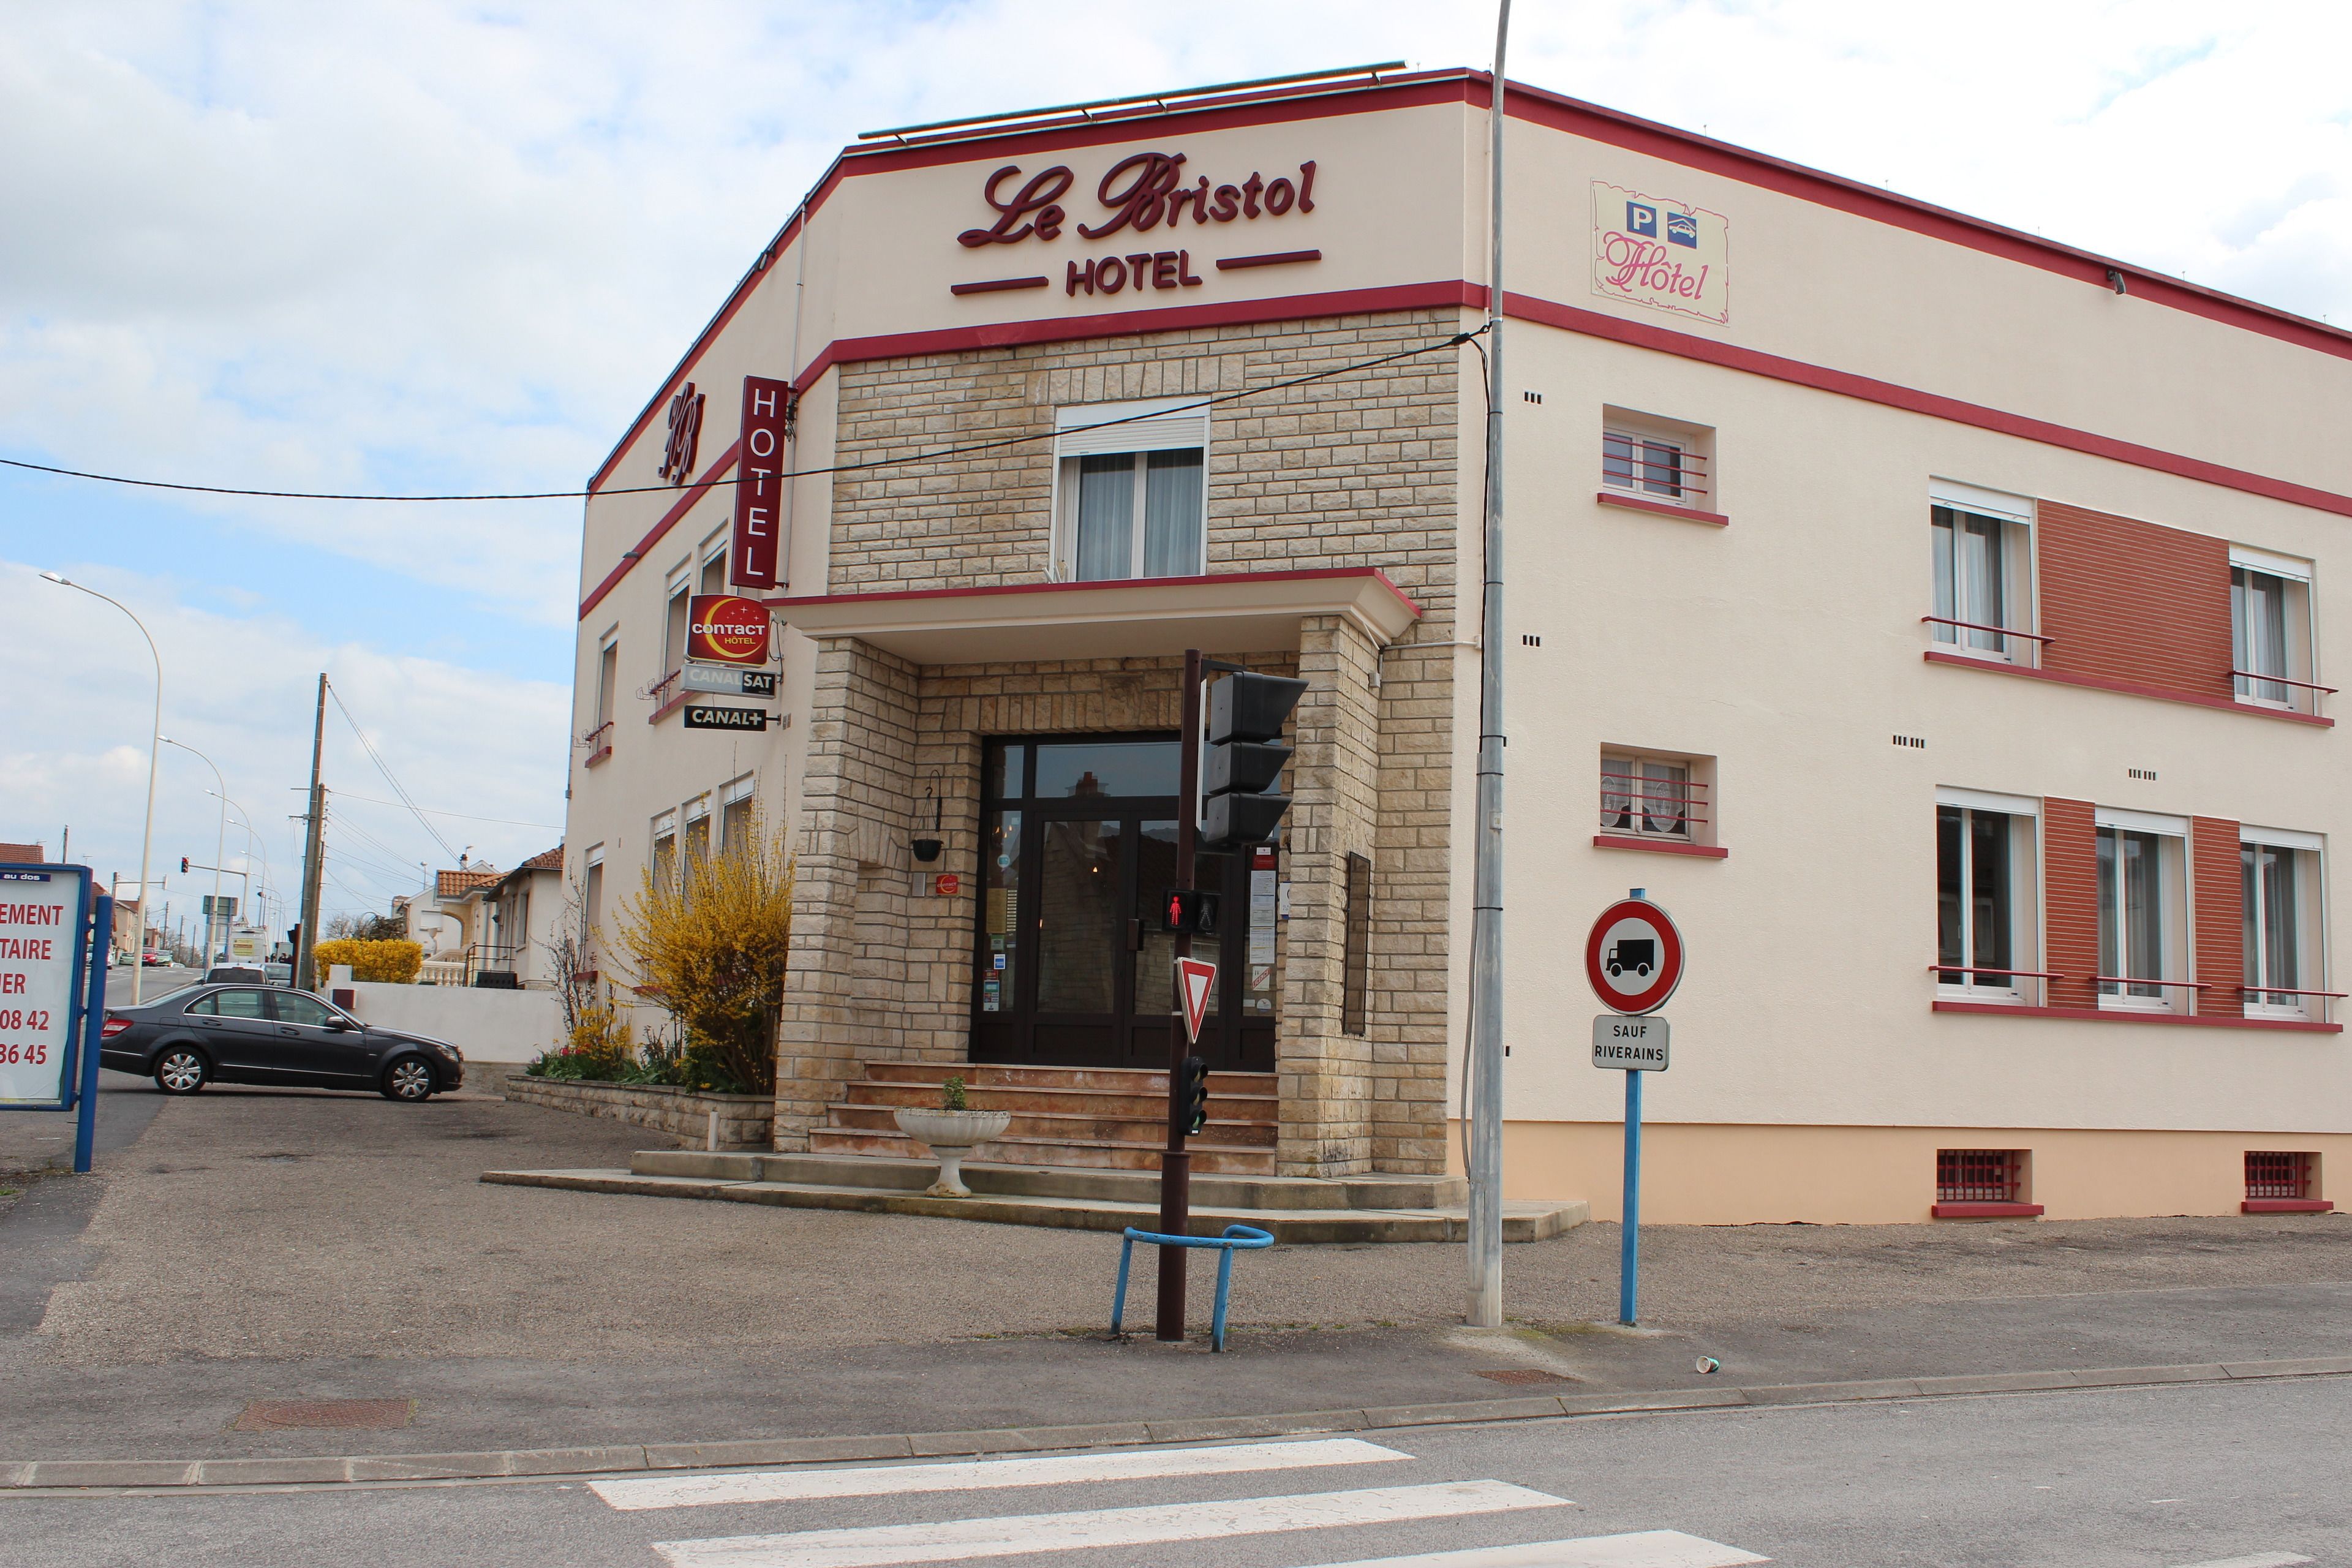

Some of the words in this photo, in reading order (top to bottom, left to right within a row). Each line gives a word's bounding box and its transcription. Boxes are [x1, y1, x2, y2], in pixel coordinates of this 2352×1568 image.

[957, 165, 1074, 247] Le
[1077, 152, 1317, 239] Bristol
[1634, 207, 1652, 230] P
[1066, 249, 1202, 296] HOTEL
[1603, 231, 1708, 300] Hôtel
[747, 388, 777, 576] HOTEL
[692, 709, 762, 725] CANAL+
[0, 939, 51, 960] TAIRE
[0, 973, 26, 994] ER
[0, 1010, 22, 1030] 08
[26, 1011, 49, 1030] 42
[1613, 1025, 1647, 1038] SAUF
[24, 1045, 47, 1065] 45
[1595, 1045, 1664, 1061] RIVERAINS
